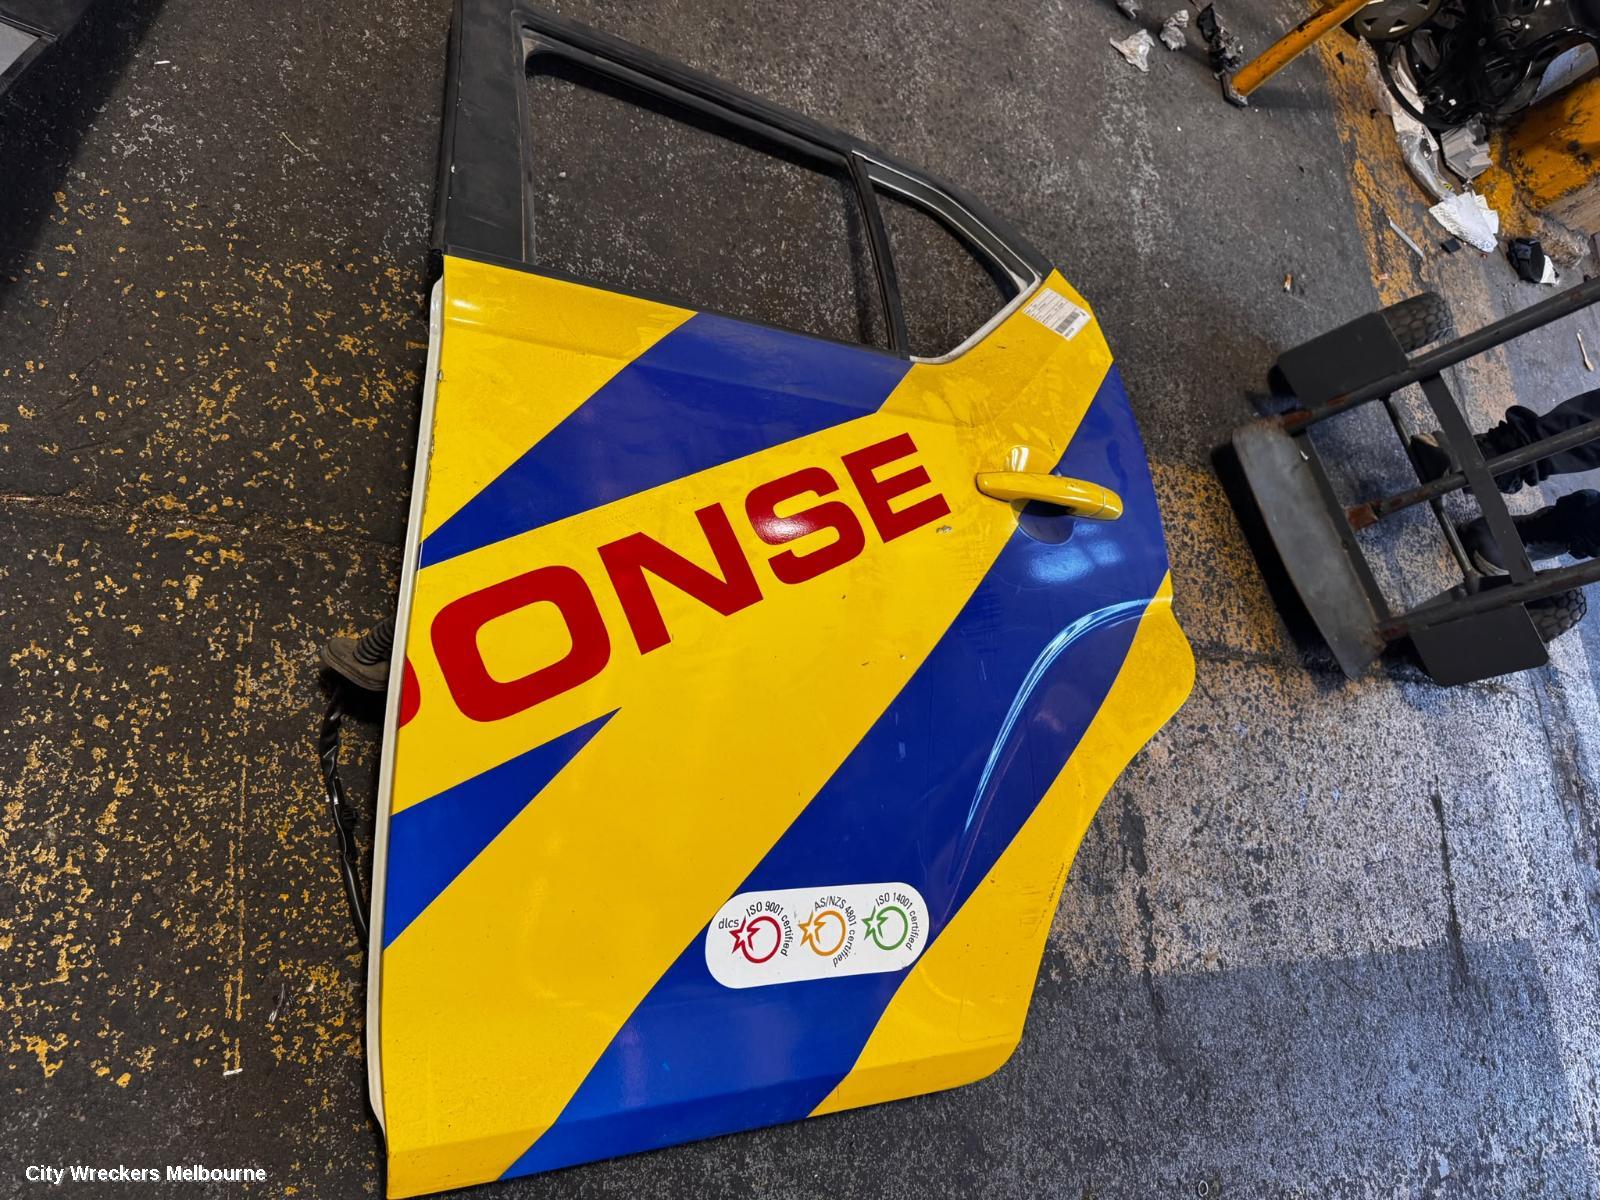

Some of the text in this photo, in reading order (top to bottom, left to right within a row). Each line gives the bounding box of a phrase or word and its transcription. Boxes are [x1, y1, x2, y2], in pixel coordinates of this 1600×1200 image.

[398, 432, 952, 728] ONSE
[718, 917, 739, 930] dlcs
[745, 901, 793, 957] ISO 9001 certified
[814, 895, 857, 968] AS/NZS 4801 certified
[875, 892, 919, 951] ISO 14001 certified
